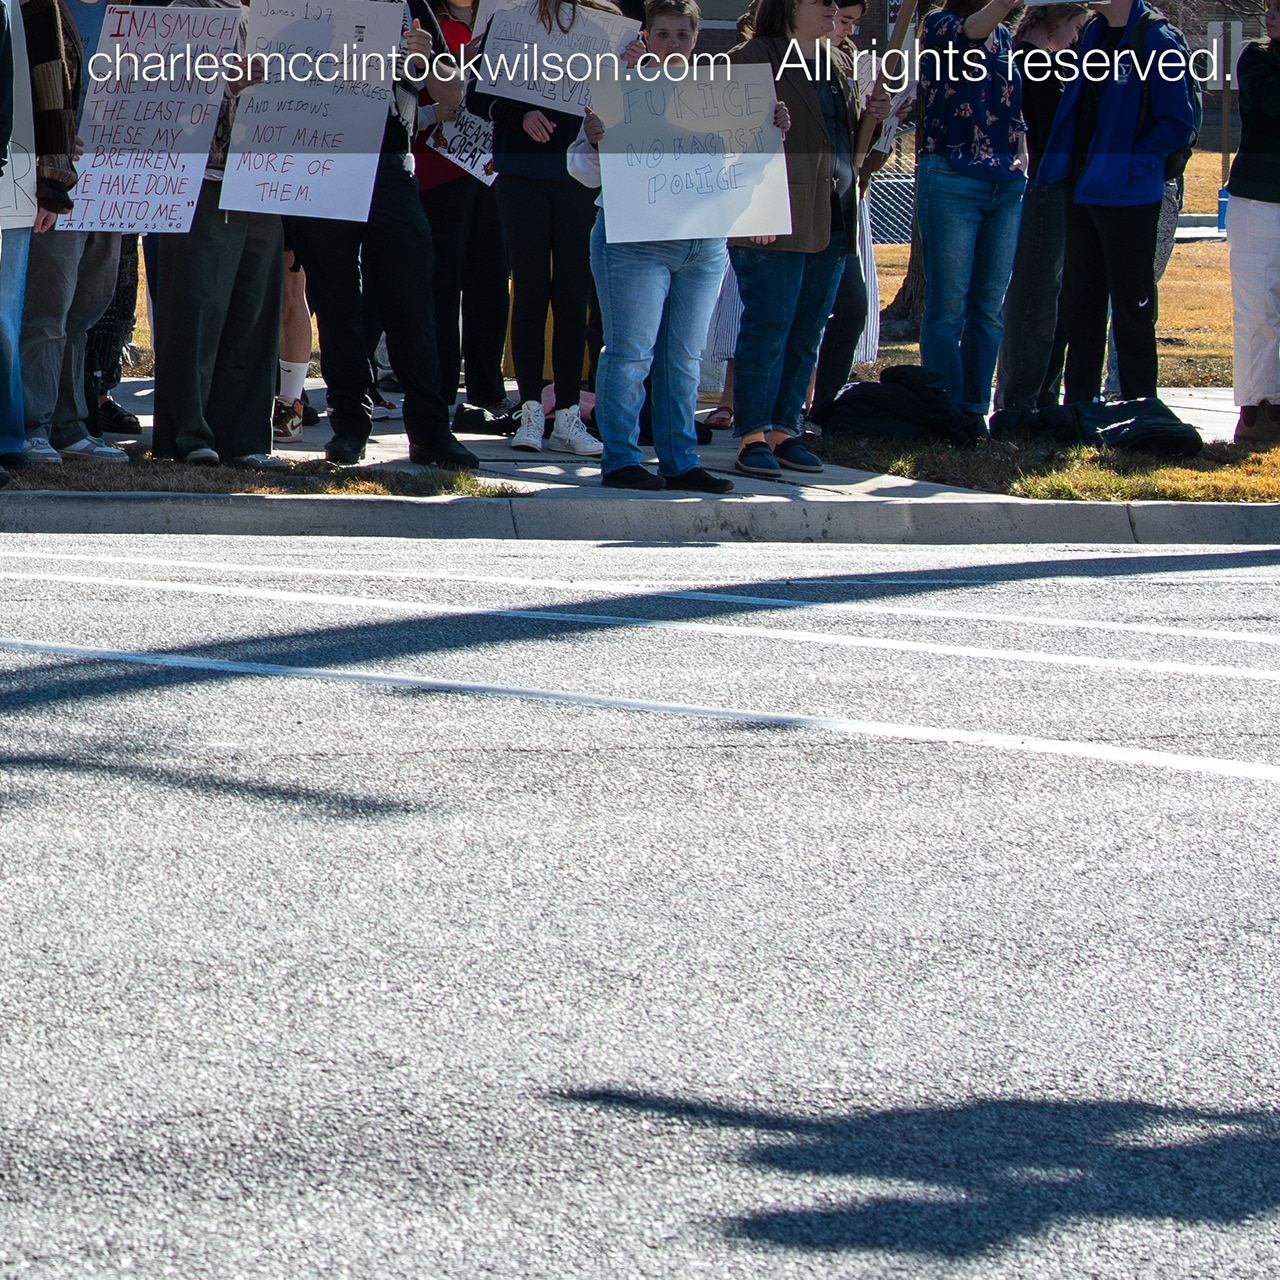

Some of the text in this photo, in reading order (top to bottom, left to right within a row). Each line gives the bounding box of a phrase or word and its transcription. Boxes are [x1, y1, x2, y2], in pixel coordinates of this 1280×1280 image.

[304, 2, 335, 23] 1:27
[493, 21, 538, 43] ALL
[114, 41, 143, 67] AS
[154, 42, 178, 67] YE
[183, 44, 231, 68] HAVE
[255, 36, 297, 65] PURE
[93, 73, 218, 95] DONE IT UNTO
[332, 75, 391, 101] FATHERLESS
[90, 99, 218, 125] THE LEAST OF
[244, 98, 269, 114] AND
[623, 81, 762, 124] FUK ICE
[88, 124, 184, 150] THESE MY
[251, 125, 345, 149] NOT MAKE
[626, 126, 764, 168] NO RACIST
[91, 145, 186, 172] BRETHREN,
[237, 151, 335, 177] MORE OF
[448, 135, 486, 170] GREAT
[74, 170, 189, 196] YE HAVE DONE
[256, 182, 312, 202] THEM.
[648, 163, 748, 205] POLICE
[63, 198, 150, 222] IT UNTO
